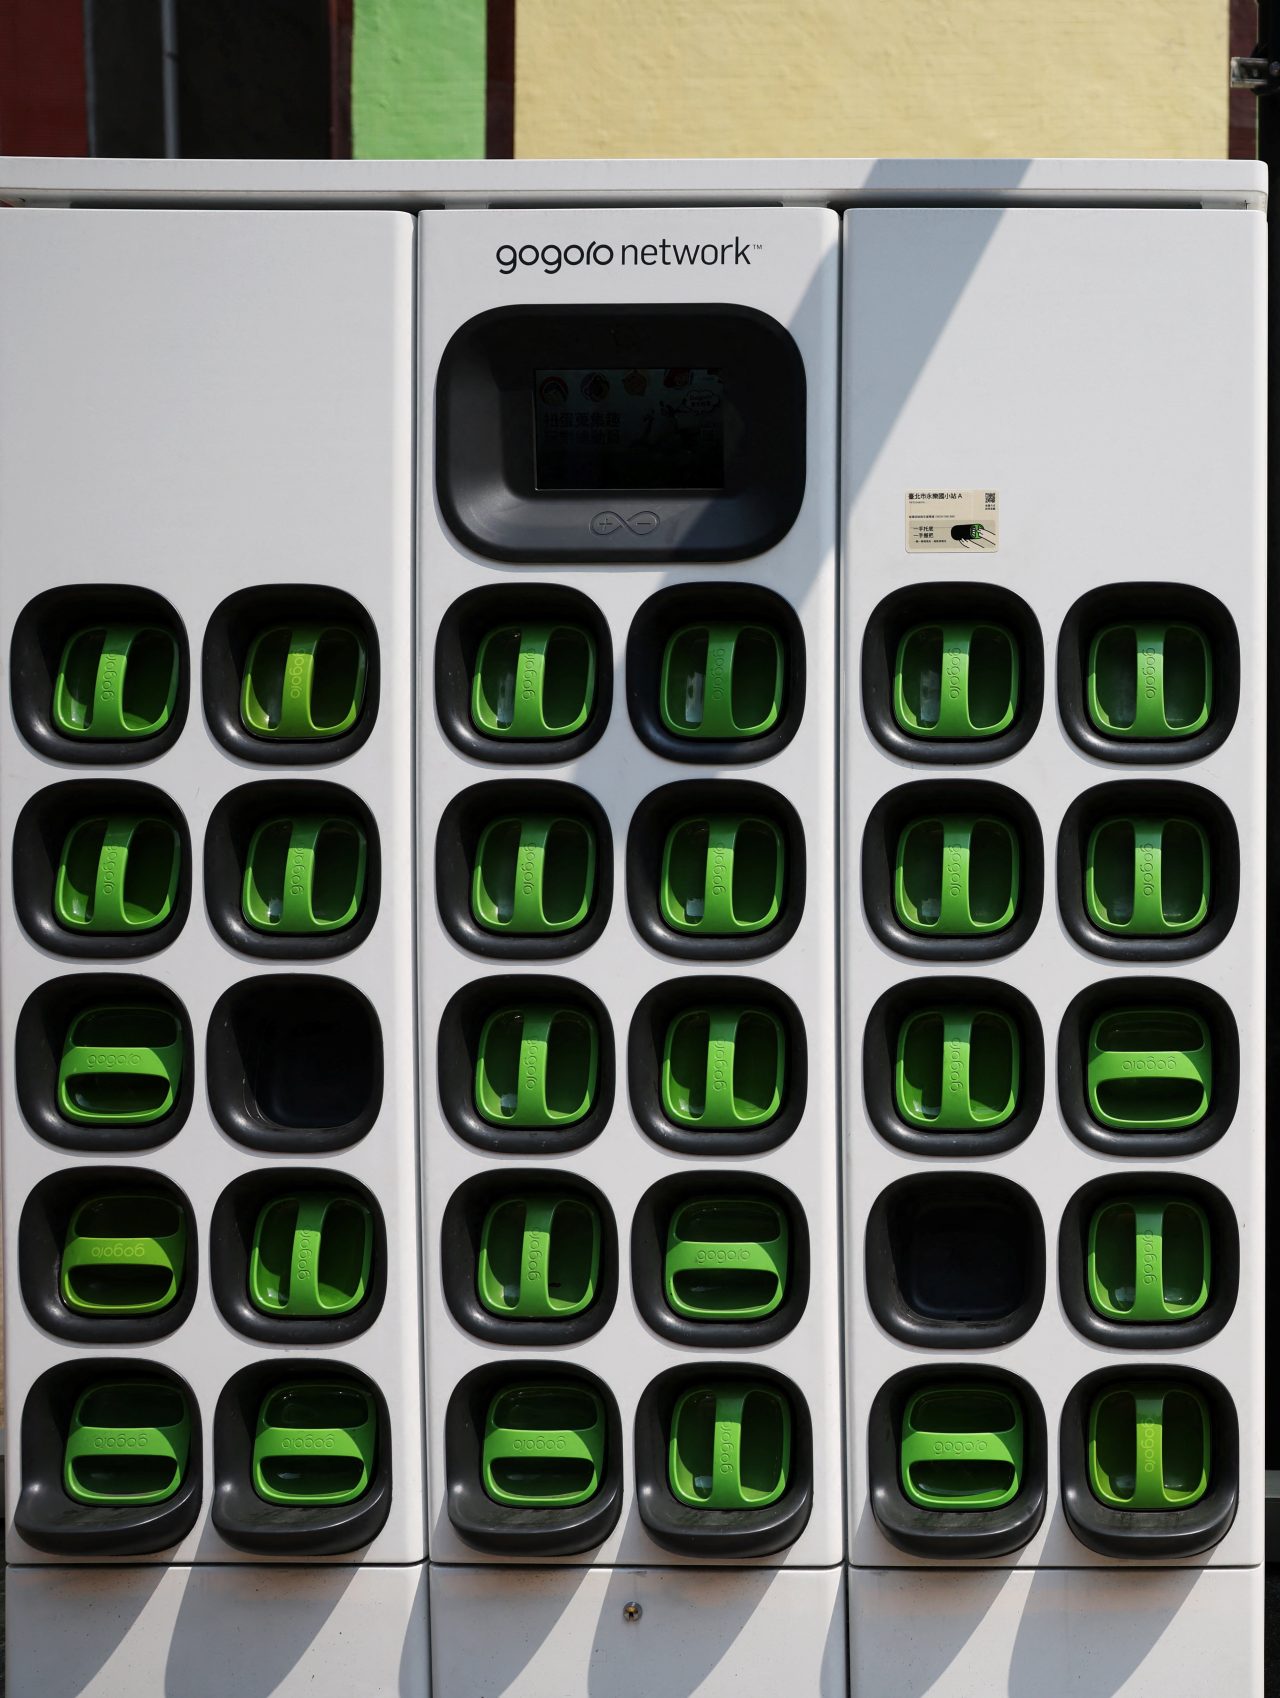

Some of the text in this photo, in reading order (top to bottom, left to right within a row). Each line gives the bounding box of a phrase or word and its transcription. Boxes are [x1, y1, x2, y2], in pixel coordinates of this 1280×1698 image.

[496, 241, 614, 274] gogoro
[522, 648, 537, 700] gogoro
[712, 648, 725, 701] gogoro
[948, 647, 961, 699] gogoro
[1143, 647, 1156, 699] gogoro
[522, 842, 537, 896] gogoro
[712, 842, 726, 896] gogoro
[948, 843, 962, 897] gogoro
[1140, 843, 1155, 896] gogoro
[87, 1052, 140, 1067] gogoro
[950, 1037, 964, 1093] gogoro
[1122, 1056, 1176, 1071] gogoro
[92, 1245, 144, 1257] gogoro
[297, 1225, 312, 1280] gogoro
[526, 1226, 542, 1281] gogoro
[696, 1248, 751, 1264] gogoro
[1144, 1230, 1156, 1285] gogoro
[94, 1434, 148, 1449] gogoro
[282, 1435, 335, 1449] gogoro
[513, 1436, 566, 1451] gogoro
[720, 1420, 733, 1474] gogoro
[933, 1440, 988, 1456] gogoro
[1139, 1417, 1154, 1472] gogoro
